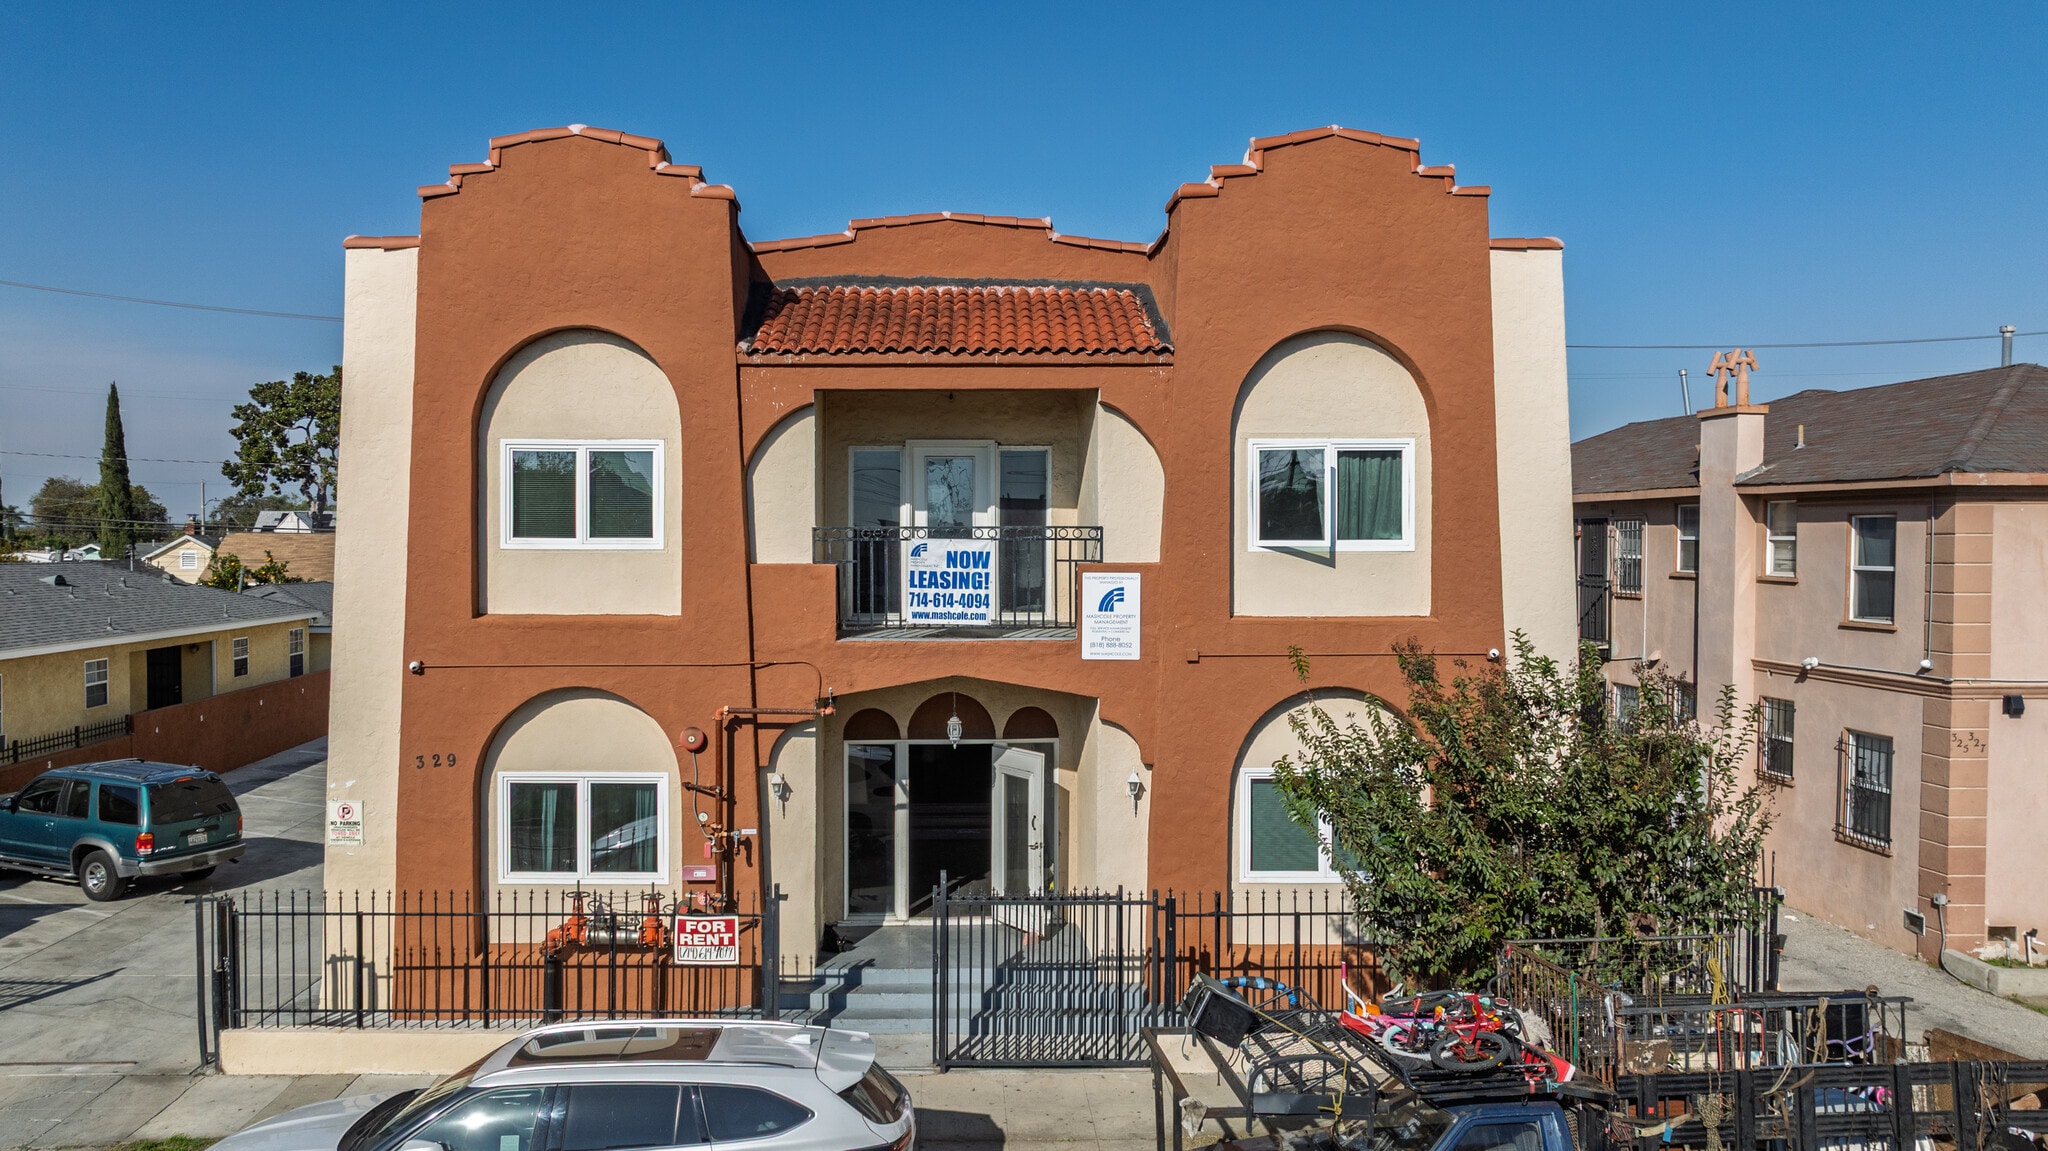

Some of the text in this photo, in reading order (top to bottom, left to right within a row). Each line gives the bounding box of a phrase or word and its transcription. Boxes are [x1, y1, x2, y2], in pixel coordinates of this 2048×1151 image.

[946, 550, 991, 569] NOW
[909, 570, 990, 590] LEASING!
[909, 592, 990, 609] 714-614-4094
[911, 611, 987, 621] www.mashcole.com
[416, 753, 457, 769] 329
[685, 921, 726, 933] FOR
[679, 933, 733, 945] RENT
